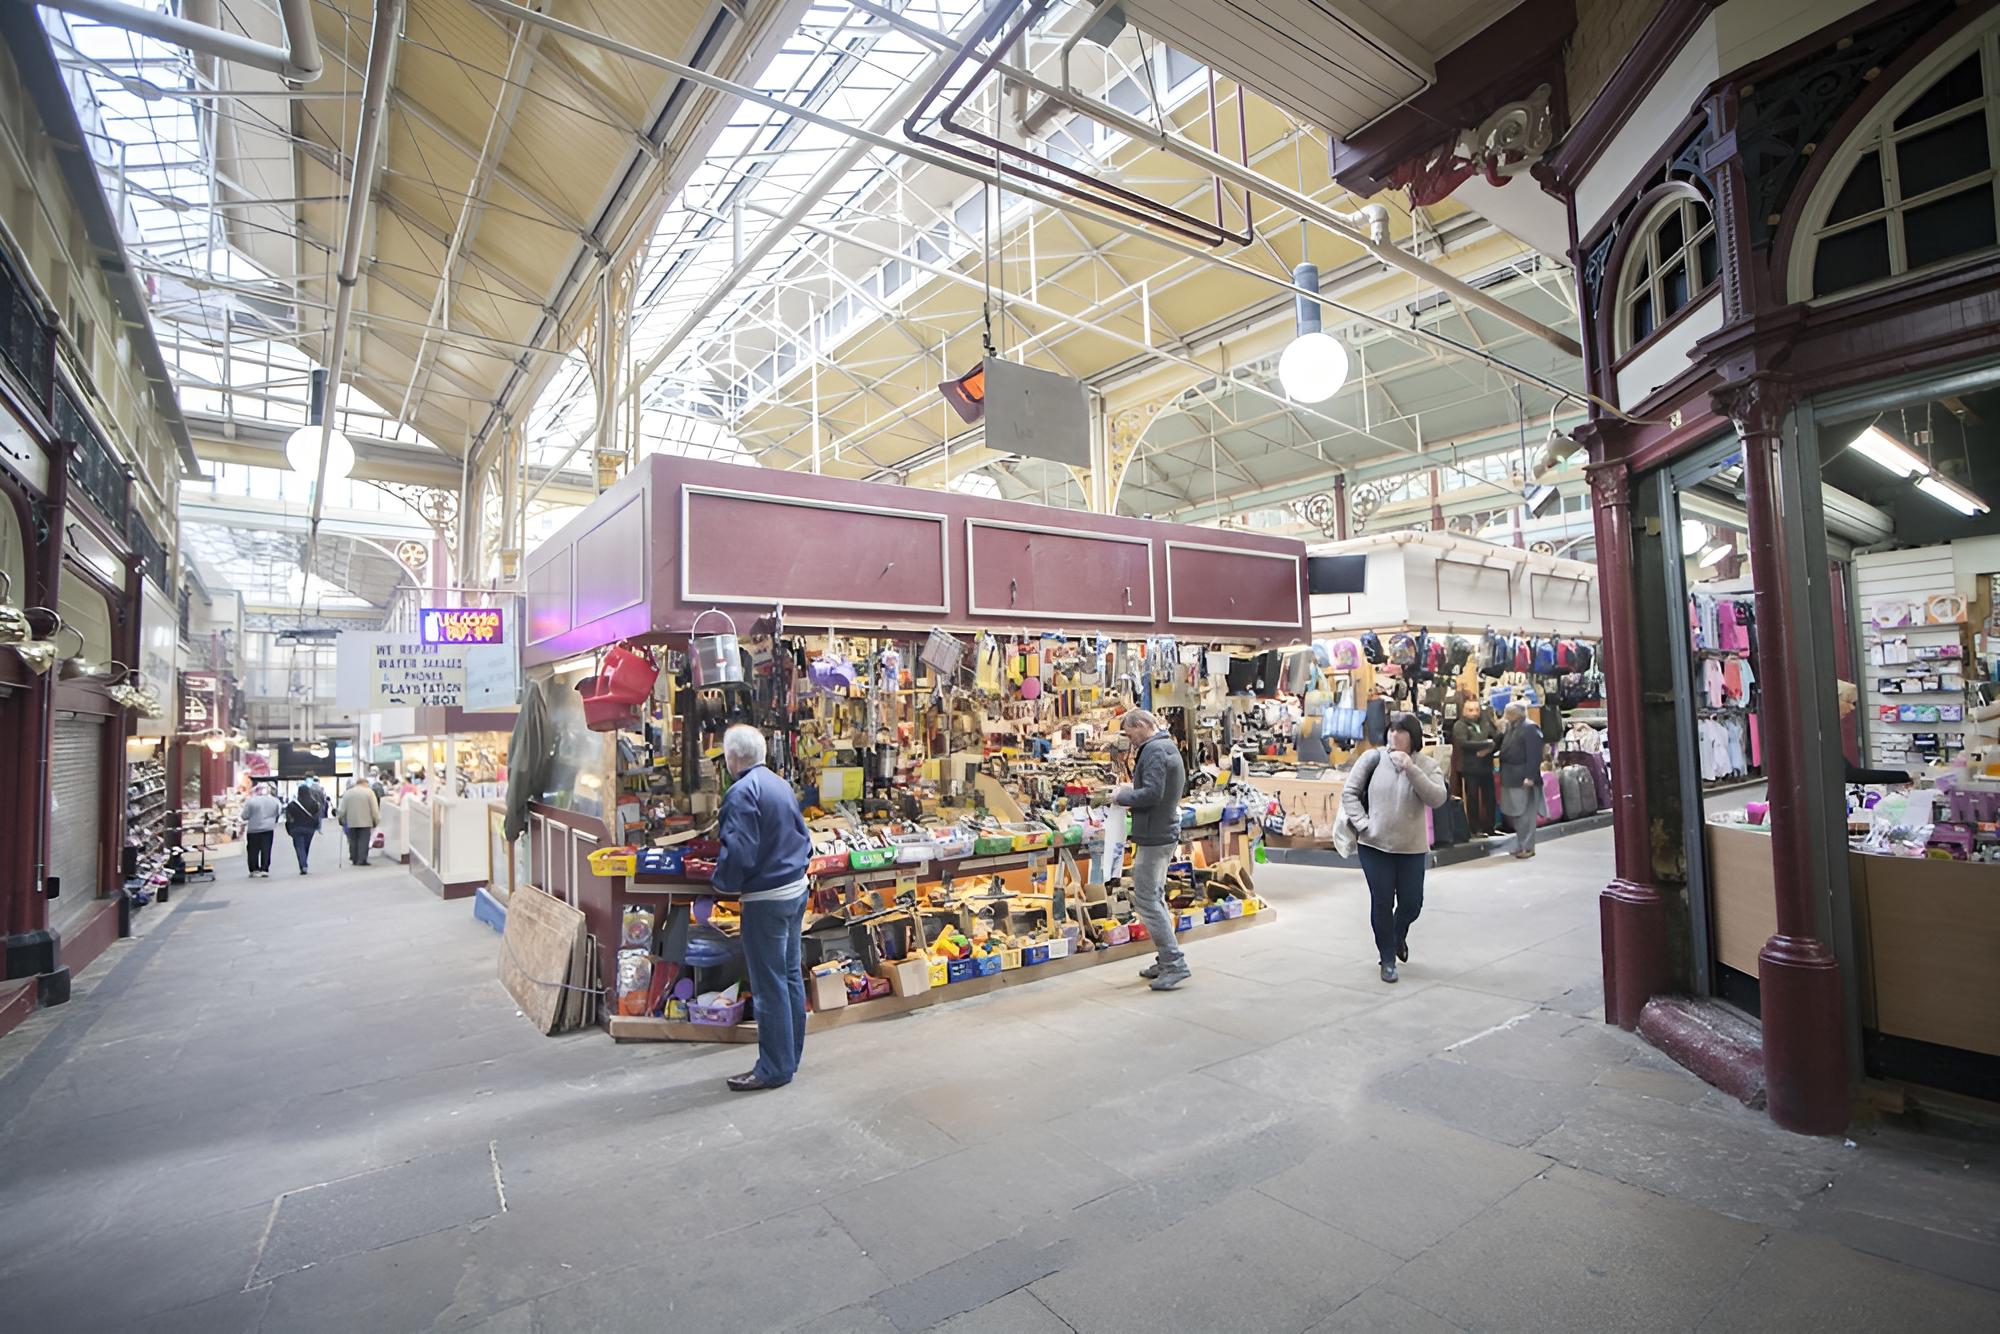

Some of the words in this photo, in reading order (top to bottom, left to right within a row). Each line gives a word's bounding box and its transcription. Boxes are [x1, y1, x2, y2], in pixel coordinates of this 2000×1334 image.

[376, 644, 391, 655] WE
[378, 658, 417, 668] WATER
[381, 683, 462, 695] PLAYSTATION
